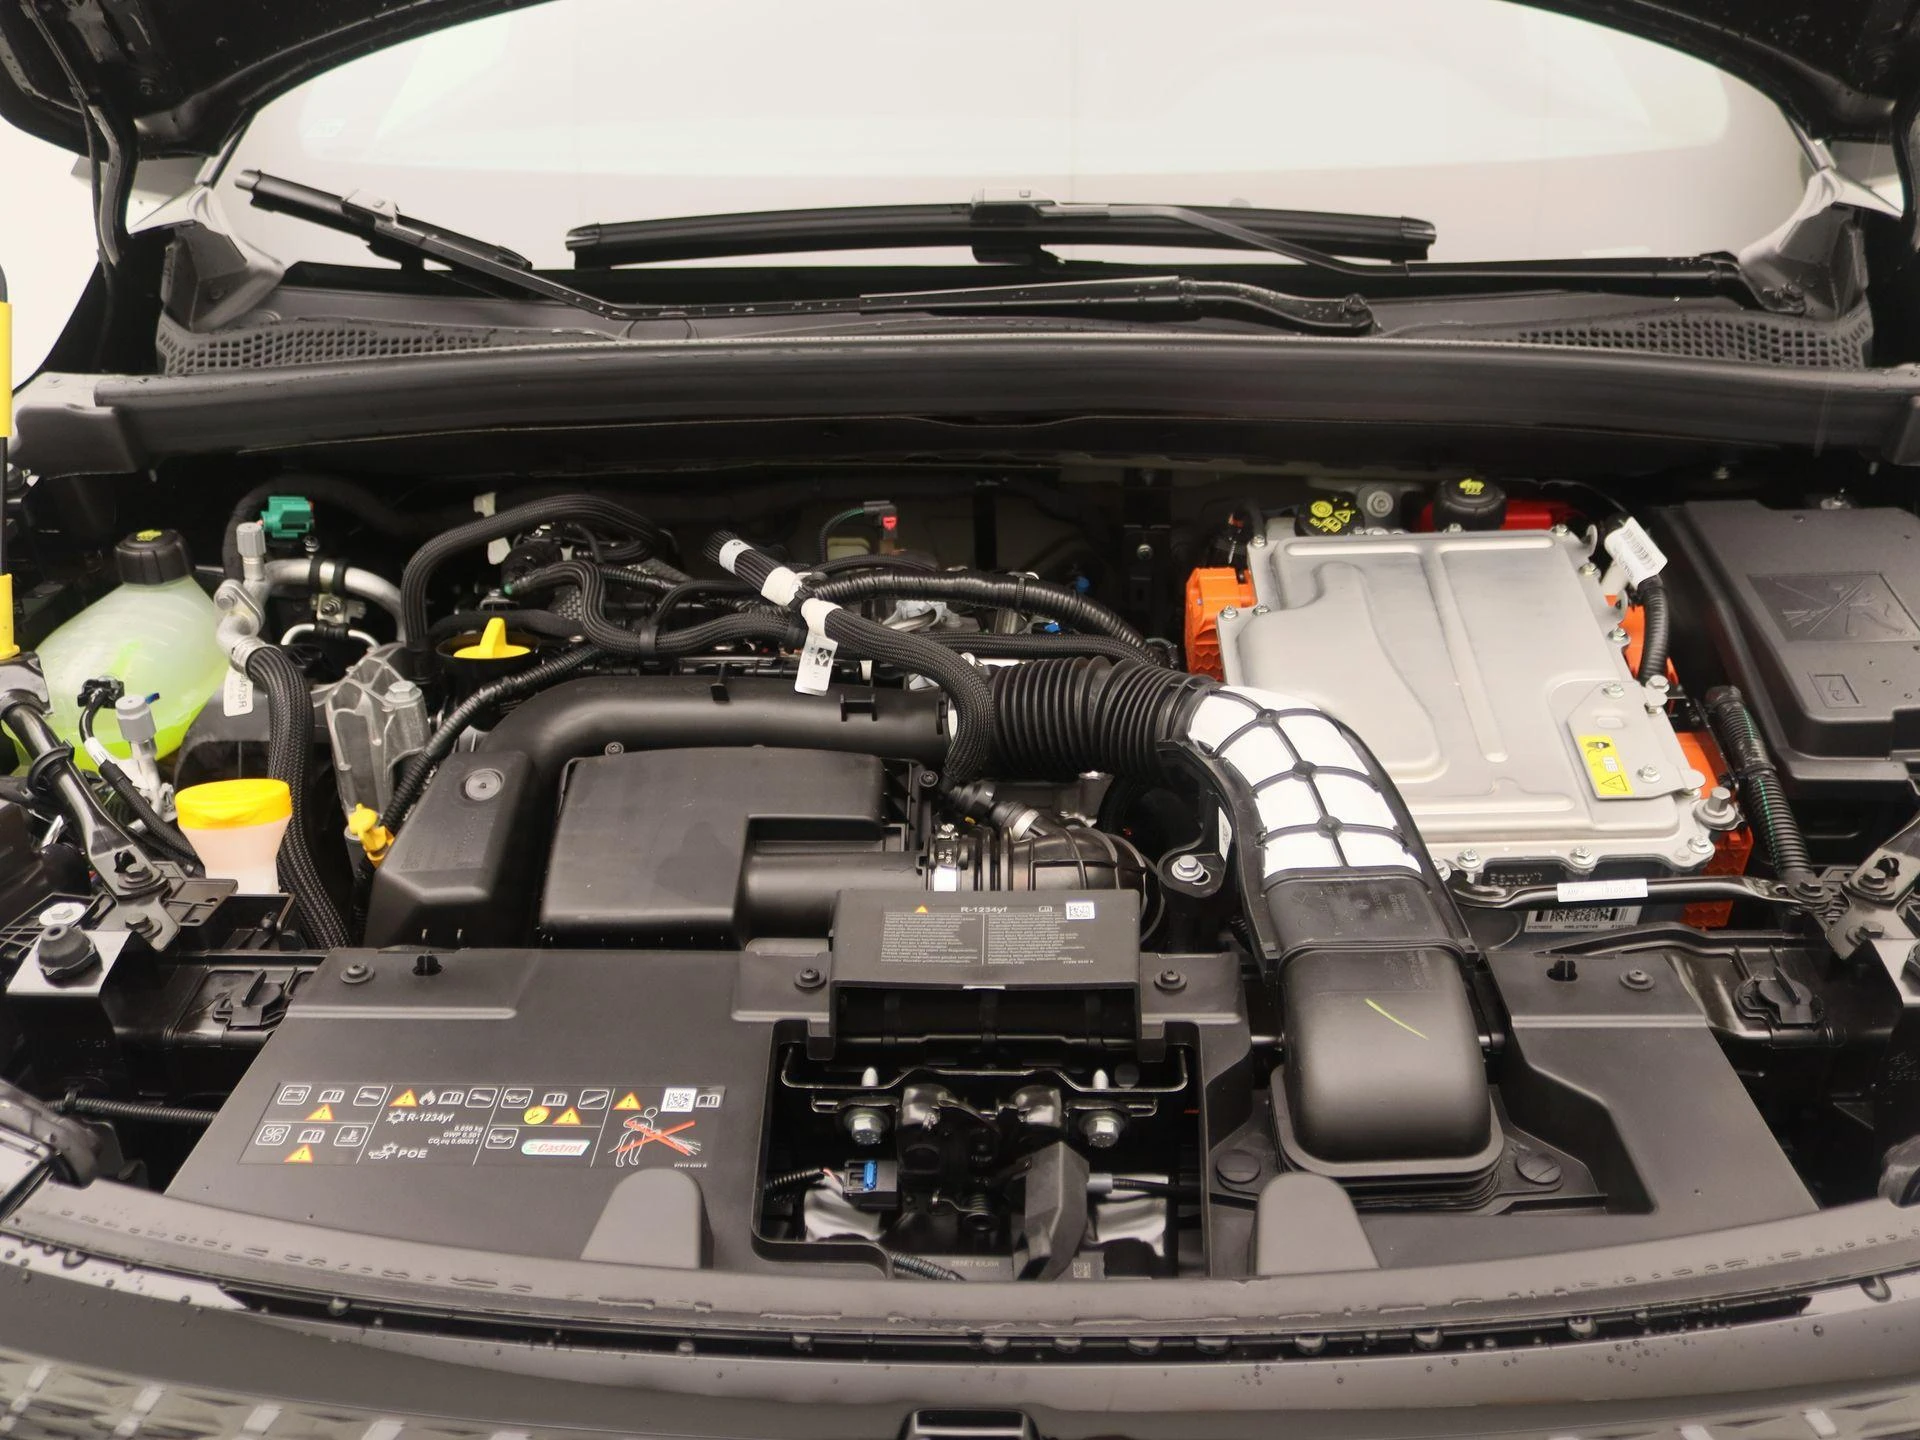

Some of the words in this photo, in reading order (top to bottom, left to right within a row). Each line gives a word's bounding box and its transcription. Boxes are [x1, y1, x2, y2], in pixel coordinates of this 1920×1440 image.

[960, 906, 1008, 915] R-1234yf
[406, 1112, 455, 1124] R-1234yf
[397, 1148, 428, 1158] POE
